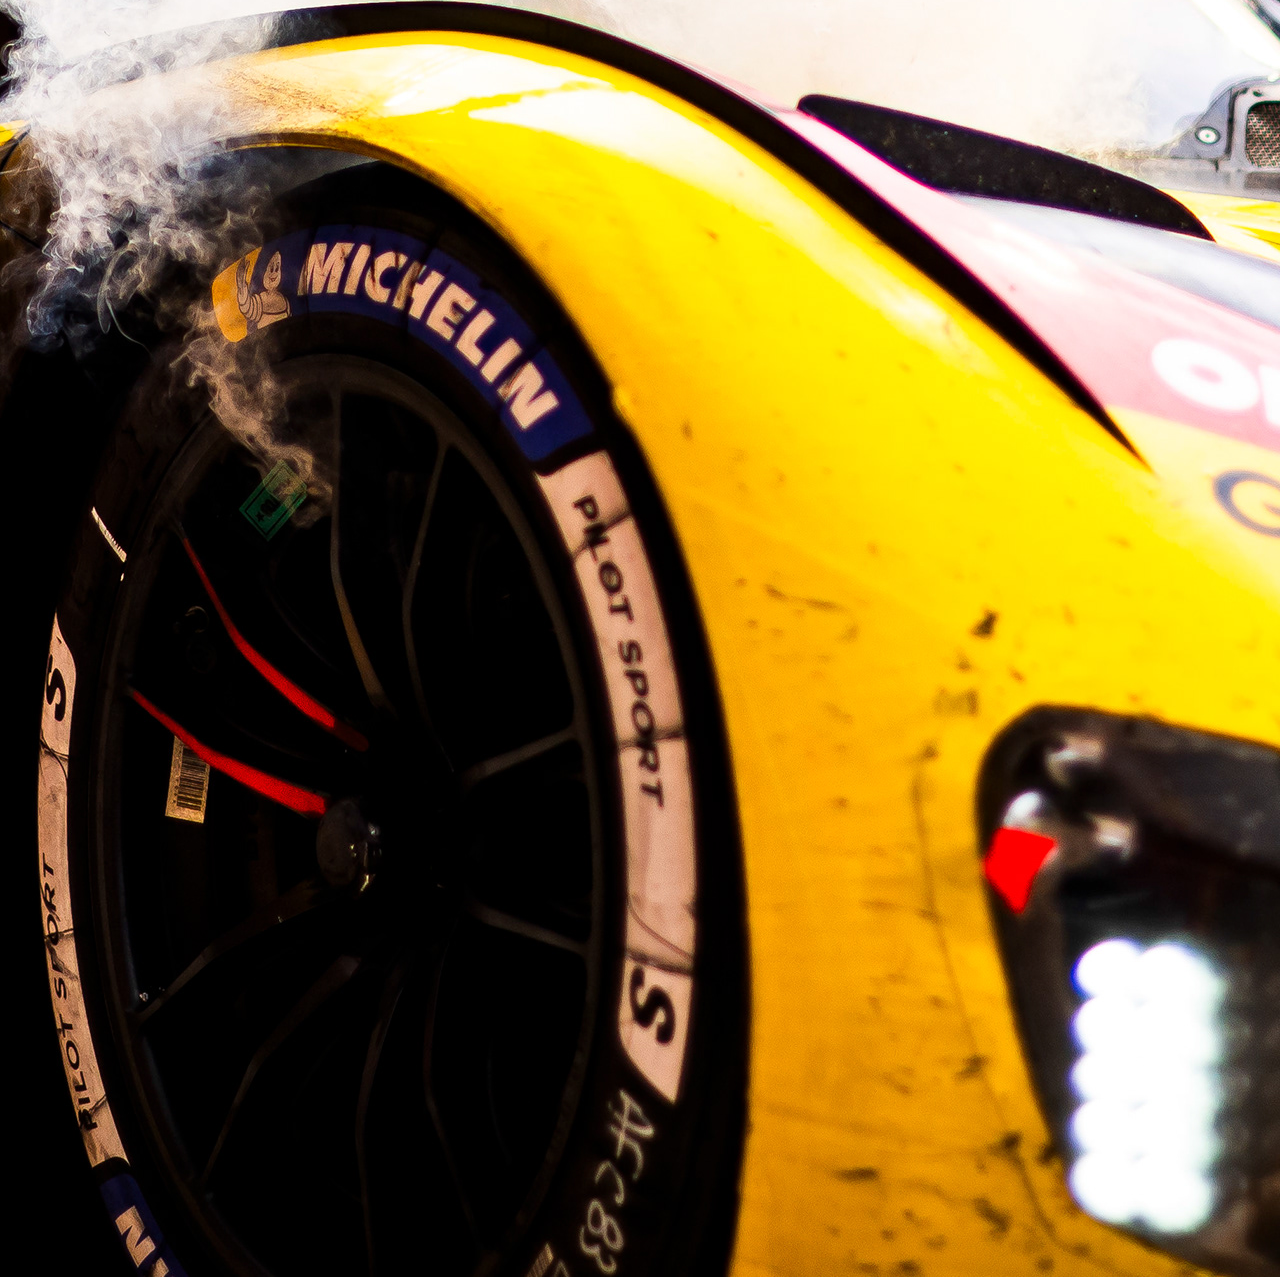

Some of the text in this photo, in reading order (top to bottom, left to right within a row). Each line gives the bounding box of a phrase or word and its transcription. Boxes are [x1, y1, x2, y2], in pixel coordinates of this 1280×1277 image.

[297, 242, 559, 430] MICHELIN
[573, 495, 664, 808] PILOT SPORT
[57, 1013, 98, 1132] PILOT
[630, 967, 675, 1044] S
